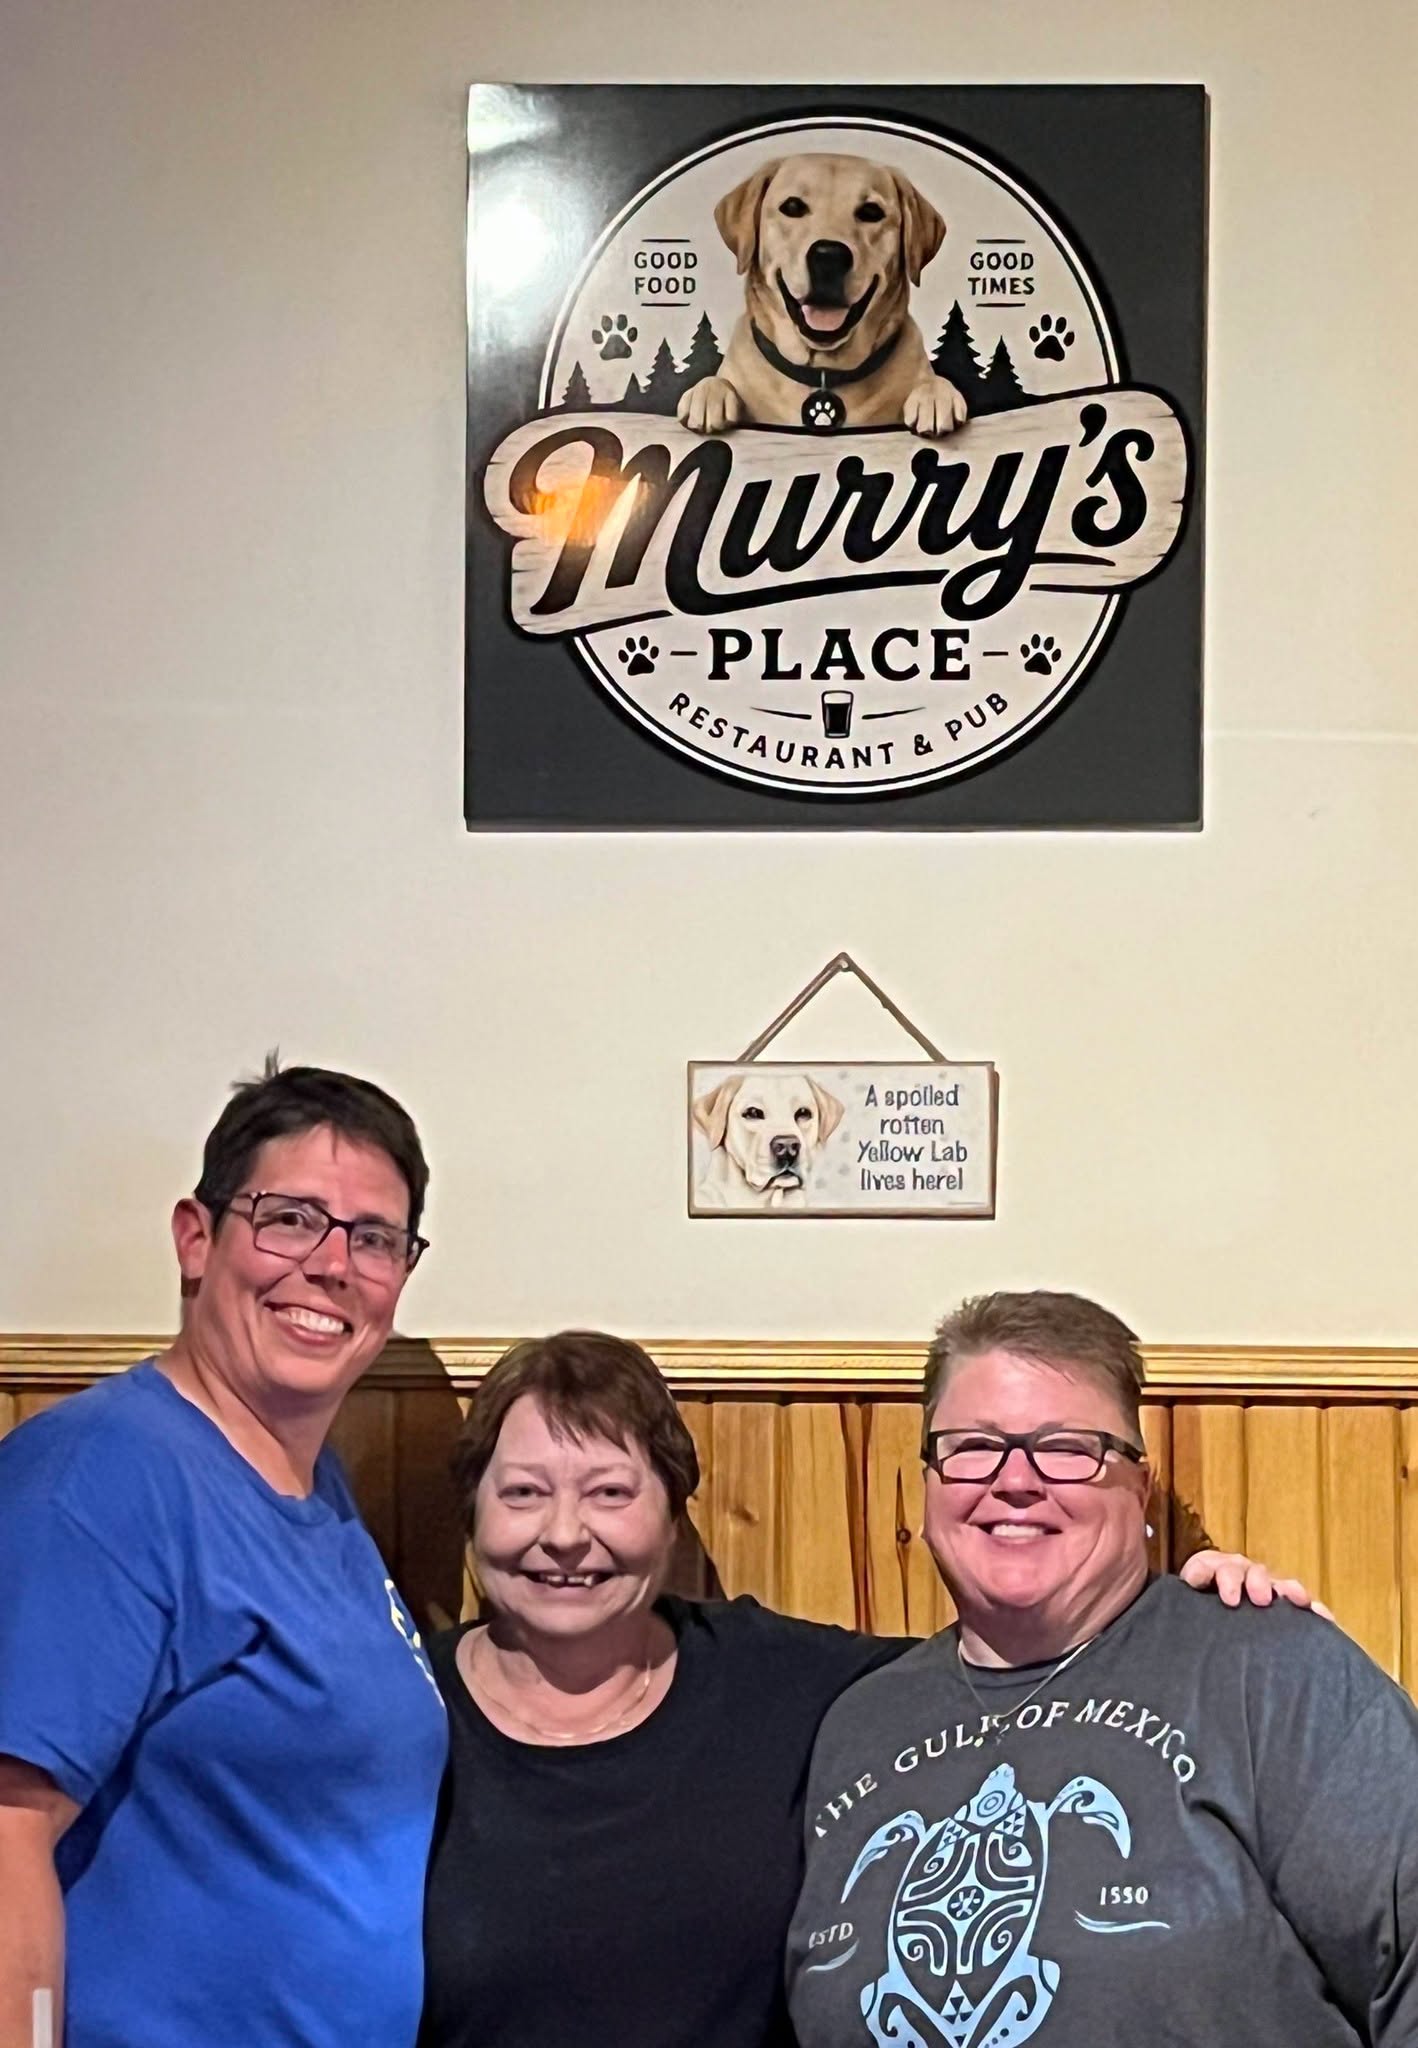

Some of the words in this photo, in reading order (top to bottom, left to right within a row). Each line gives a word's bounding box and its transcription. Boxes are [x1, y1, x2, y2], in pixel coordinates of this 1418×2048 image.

[633, 251, 698, 271] GOOD
[969, 252, 1035, 272] GOOD
[634, 277, 697, 296] FOOD
[968, 277, 1036, 297] TIMES
[508, 403, 1155, 621] Murry's
[708, 628, 972, 682] PLACE
[669, 692, 894, 769] RESTAURANT
[913, 734, 934, 756] &
[945, 693, 1008, 741] PUB
[865, 1084, 878, 1107] A
[884, 1084, 959, 1111] spoiled
[880, 1115, 945, 1135] rotten
[857, 1140, 925, 1163] Yellow
[931, 1140, 968, 1162] Lab
[861, 1168, 906, 1190] lives
[1016, 1701, 1070, 1729] OF
[1074, 1699, 1196, 1783] MEXICO
